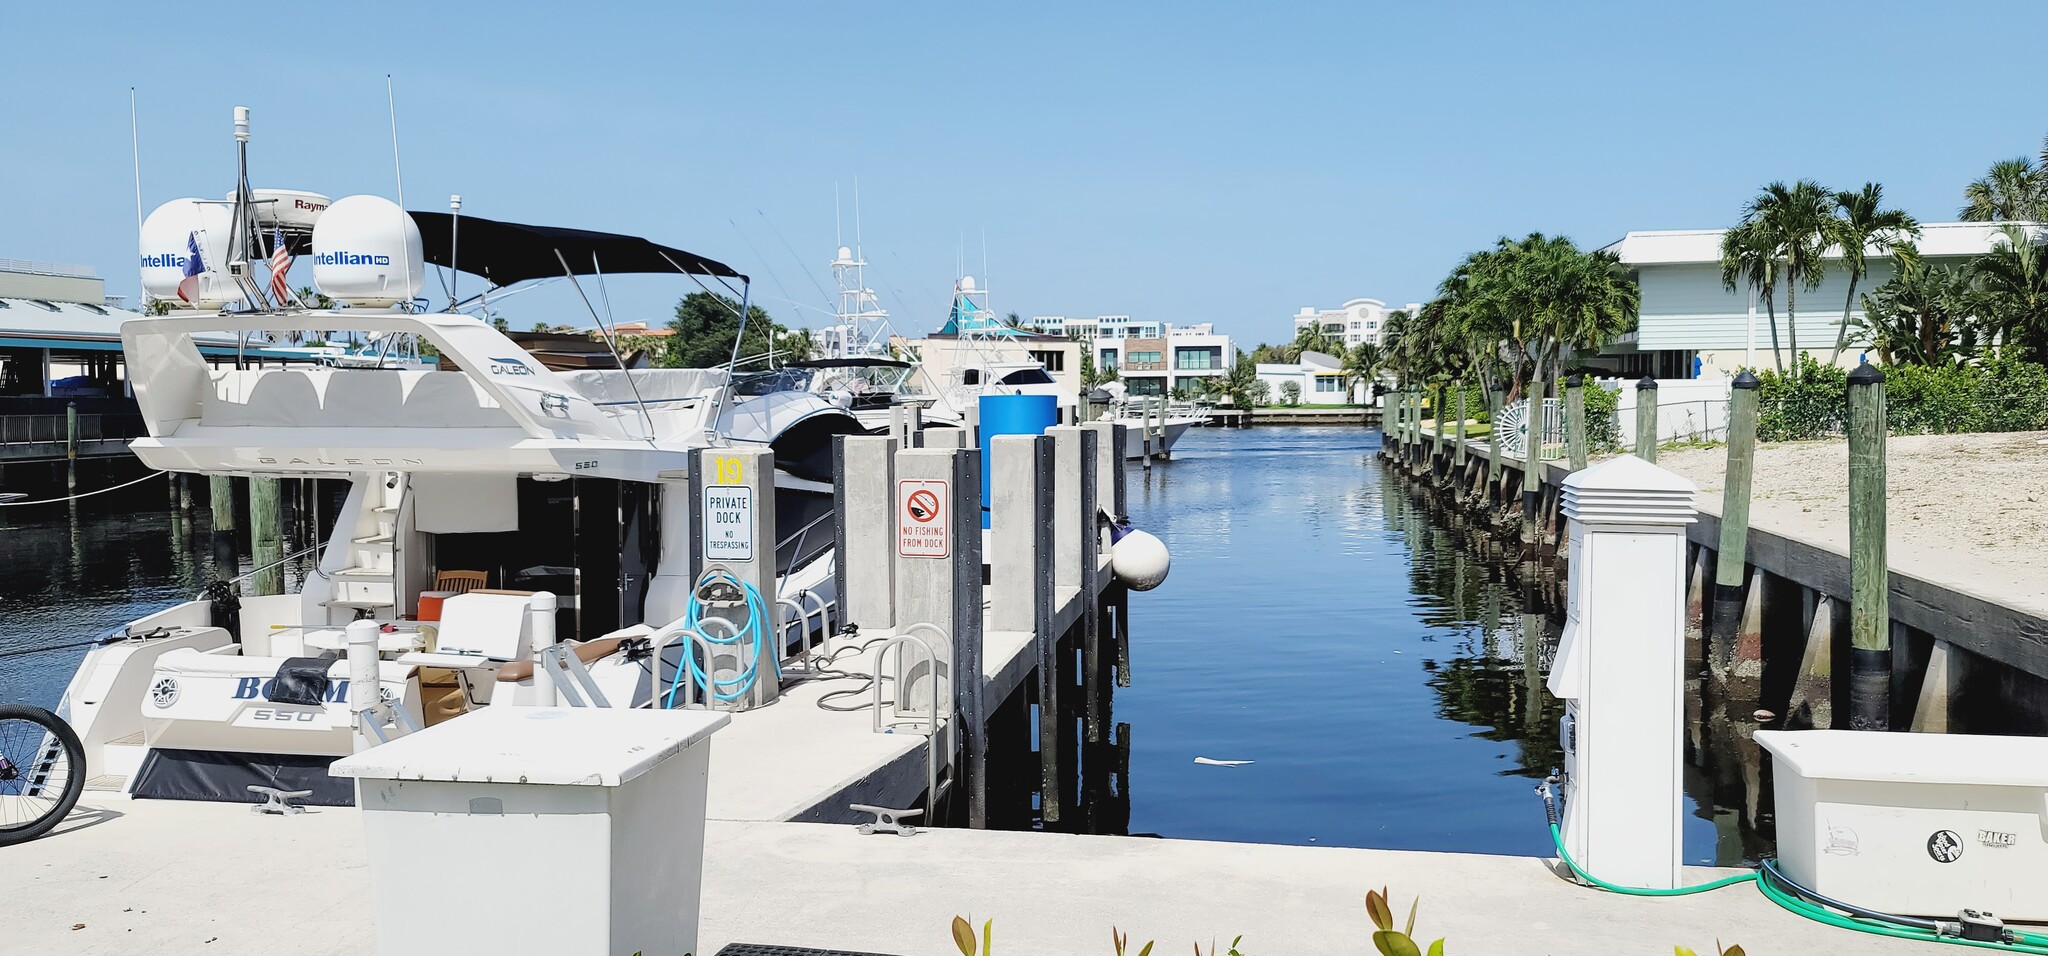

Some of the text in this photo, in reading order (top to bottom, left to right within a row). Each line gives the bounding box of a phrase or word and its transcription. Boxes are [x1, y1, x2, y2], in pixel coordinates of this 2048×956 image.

[314, 251, 389, 265] Intellian HD
[491, 365, 535, 375] GALEON
[257, 457, 424, 465] GALEON
[716, 456, 742, 484] 19
[710, 497, 747, 509] PRIVATE
[716, 512, 741, 523] DOCK
[903, 527, 943, 535] NO FISHING
[710, 541, 748, 549] TRESPASSING
[903, 539, 943, 547] FROM DOCK
[254, 710, 315, 721] 550
[1978, 830, 2016, 845] BAKER
